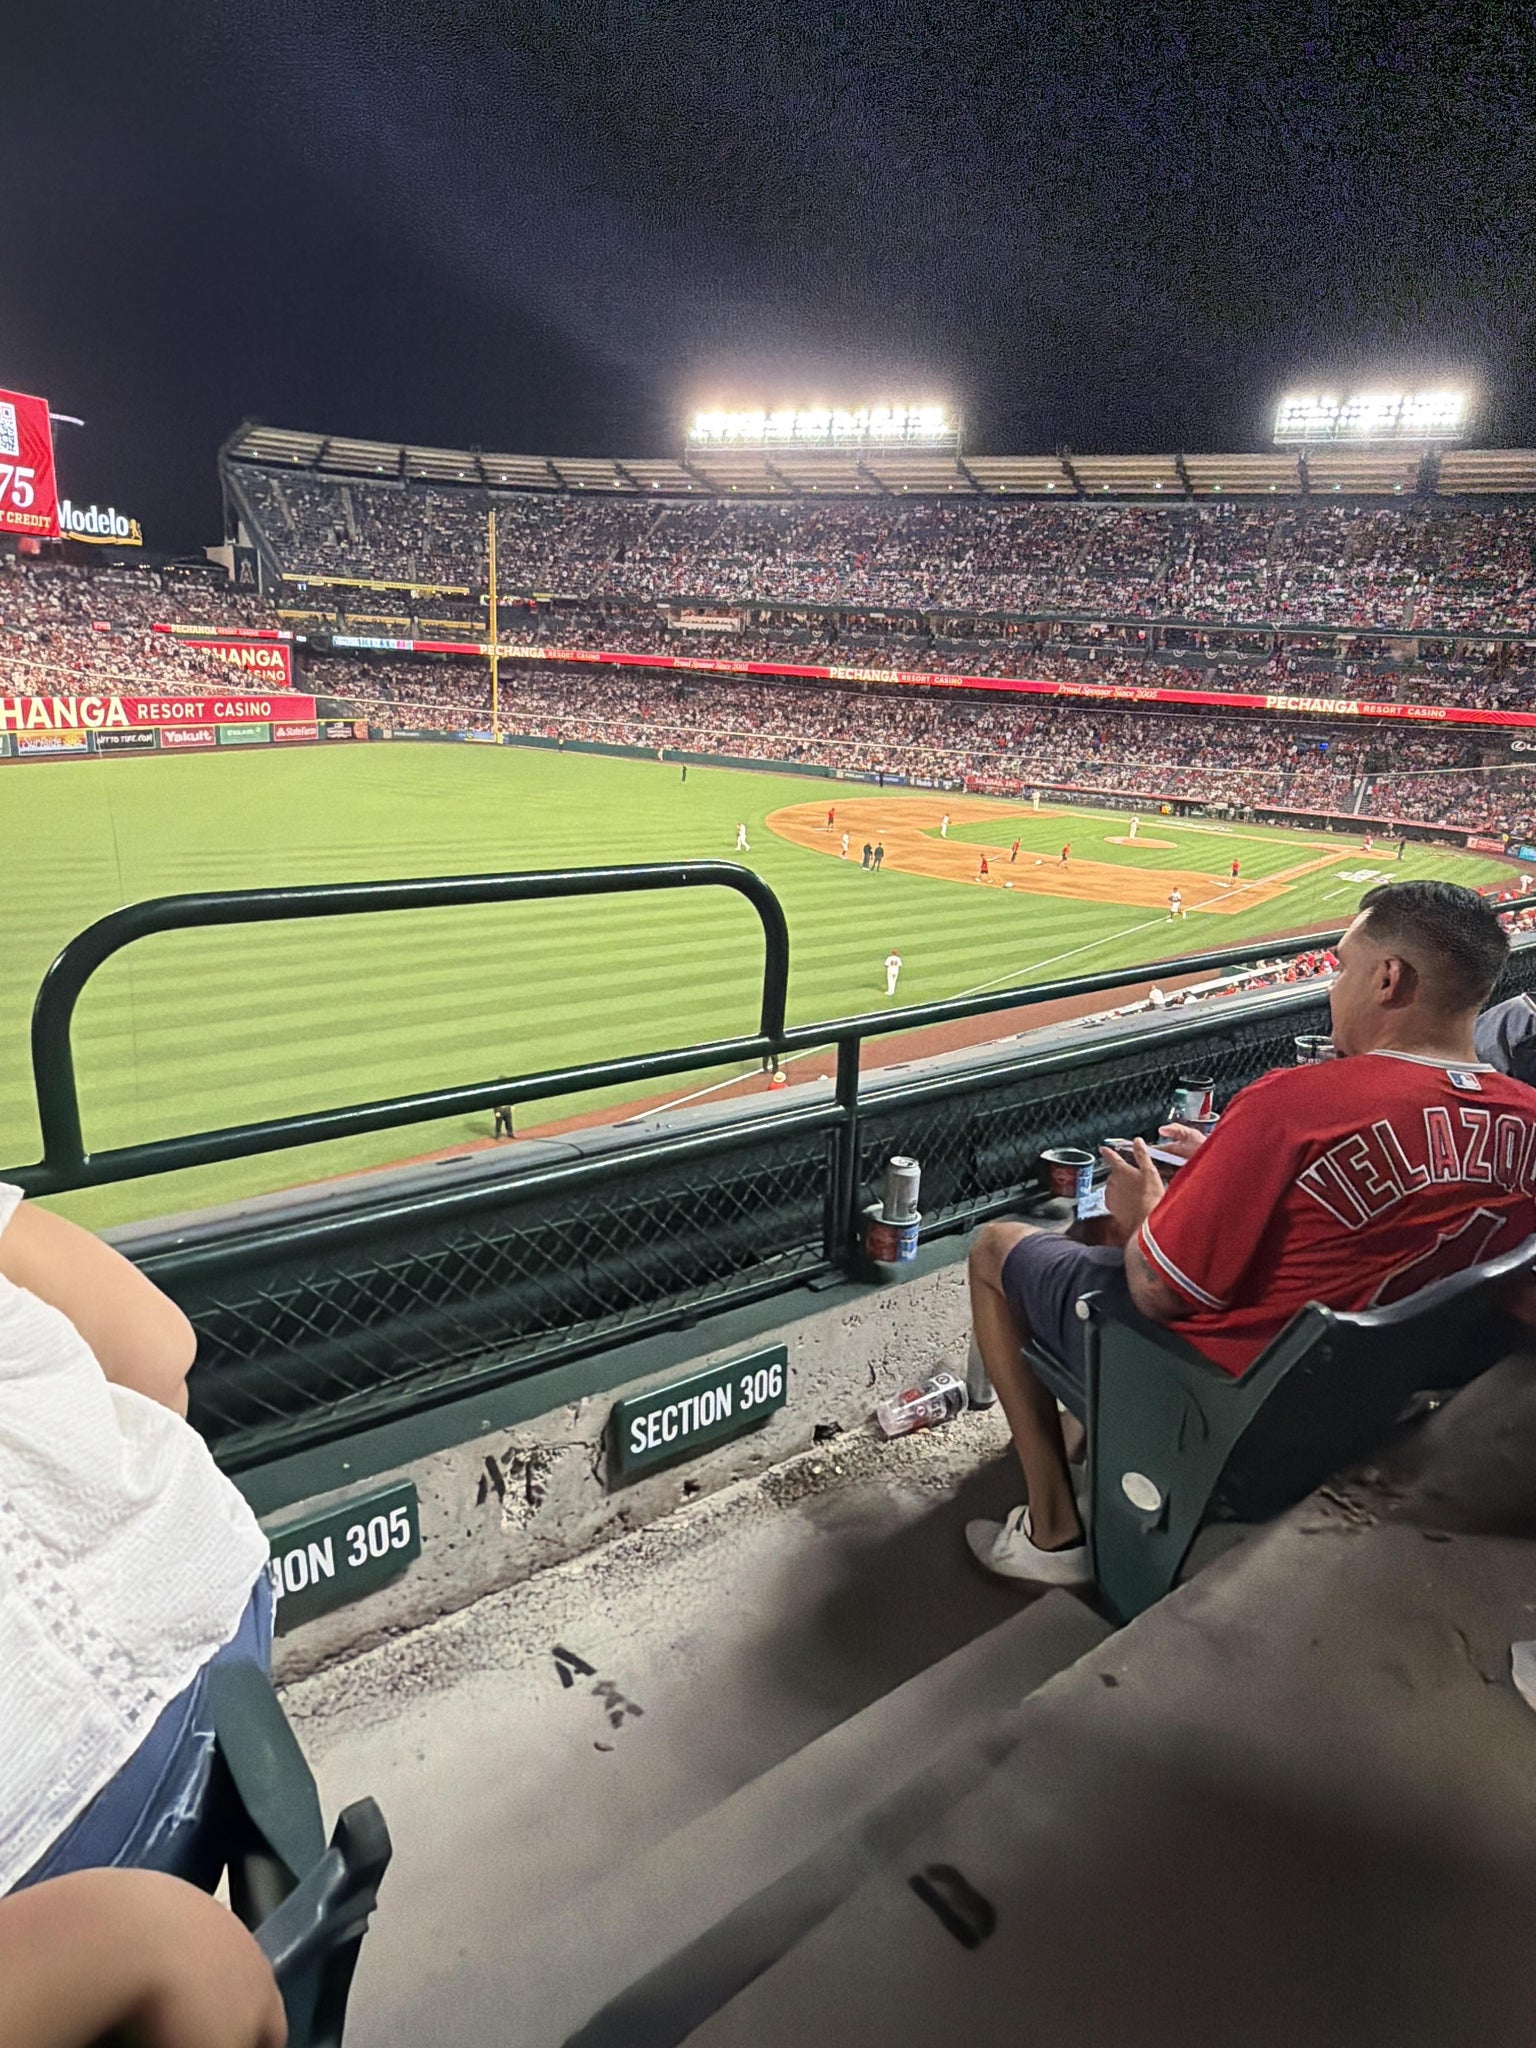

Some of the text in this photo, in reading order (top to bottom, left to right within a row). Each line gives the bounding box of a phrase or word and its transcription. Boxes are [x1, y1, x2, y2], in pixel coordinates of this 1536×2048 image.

[7, 511, 51, 529] CREDIT
[57, 500, 129, 536] Modelo
[201, 647, 284, 667] HANGA
[480, 644, 546, 659] PECHANGA
[829, 667, 962, 685] PECHANGA RESORT CASINO
[1058, 684, 1081, 694] Proud
[0, 697, 271, 730] HANGA RESORT CASINO
[1266, 695, 1446, 717] PECHANGA RESORT CASINO
[165, 731, 213, 742] Yakult
[630, 1363, 782, 1454] SECTION 306
[346, 1505, 410, 1567] 305
